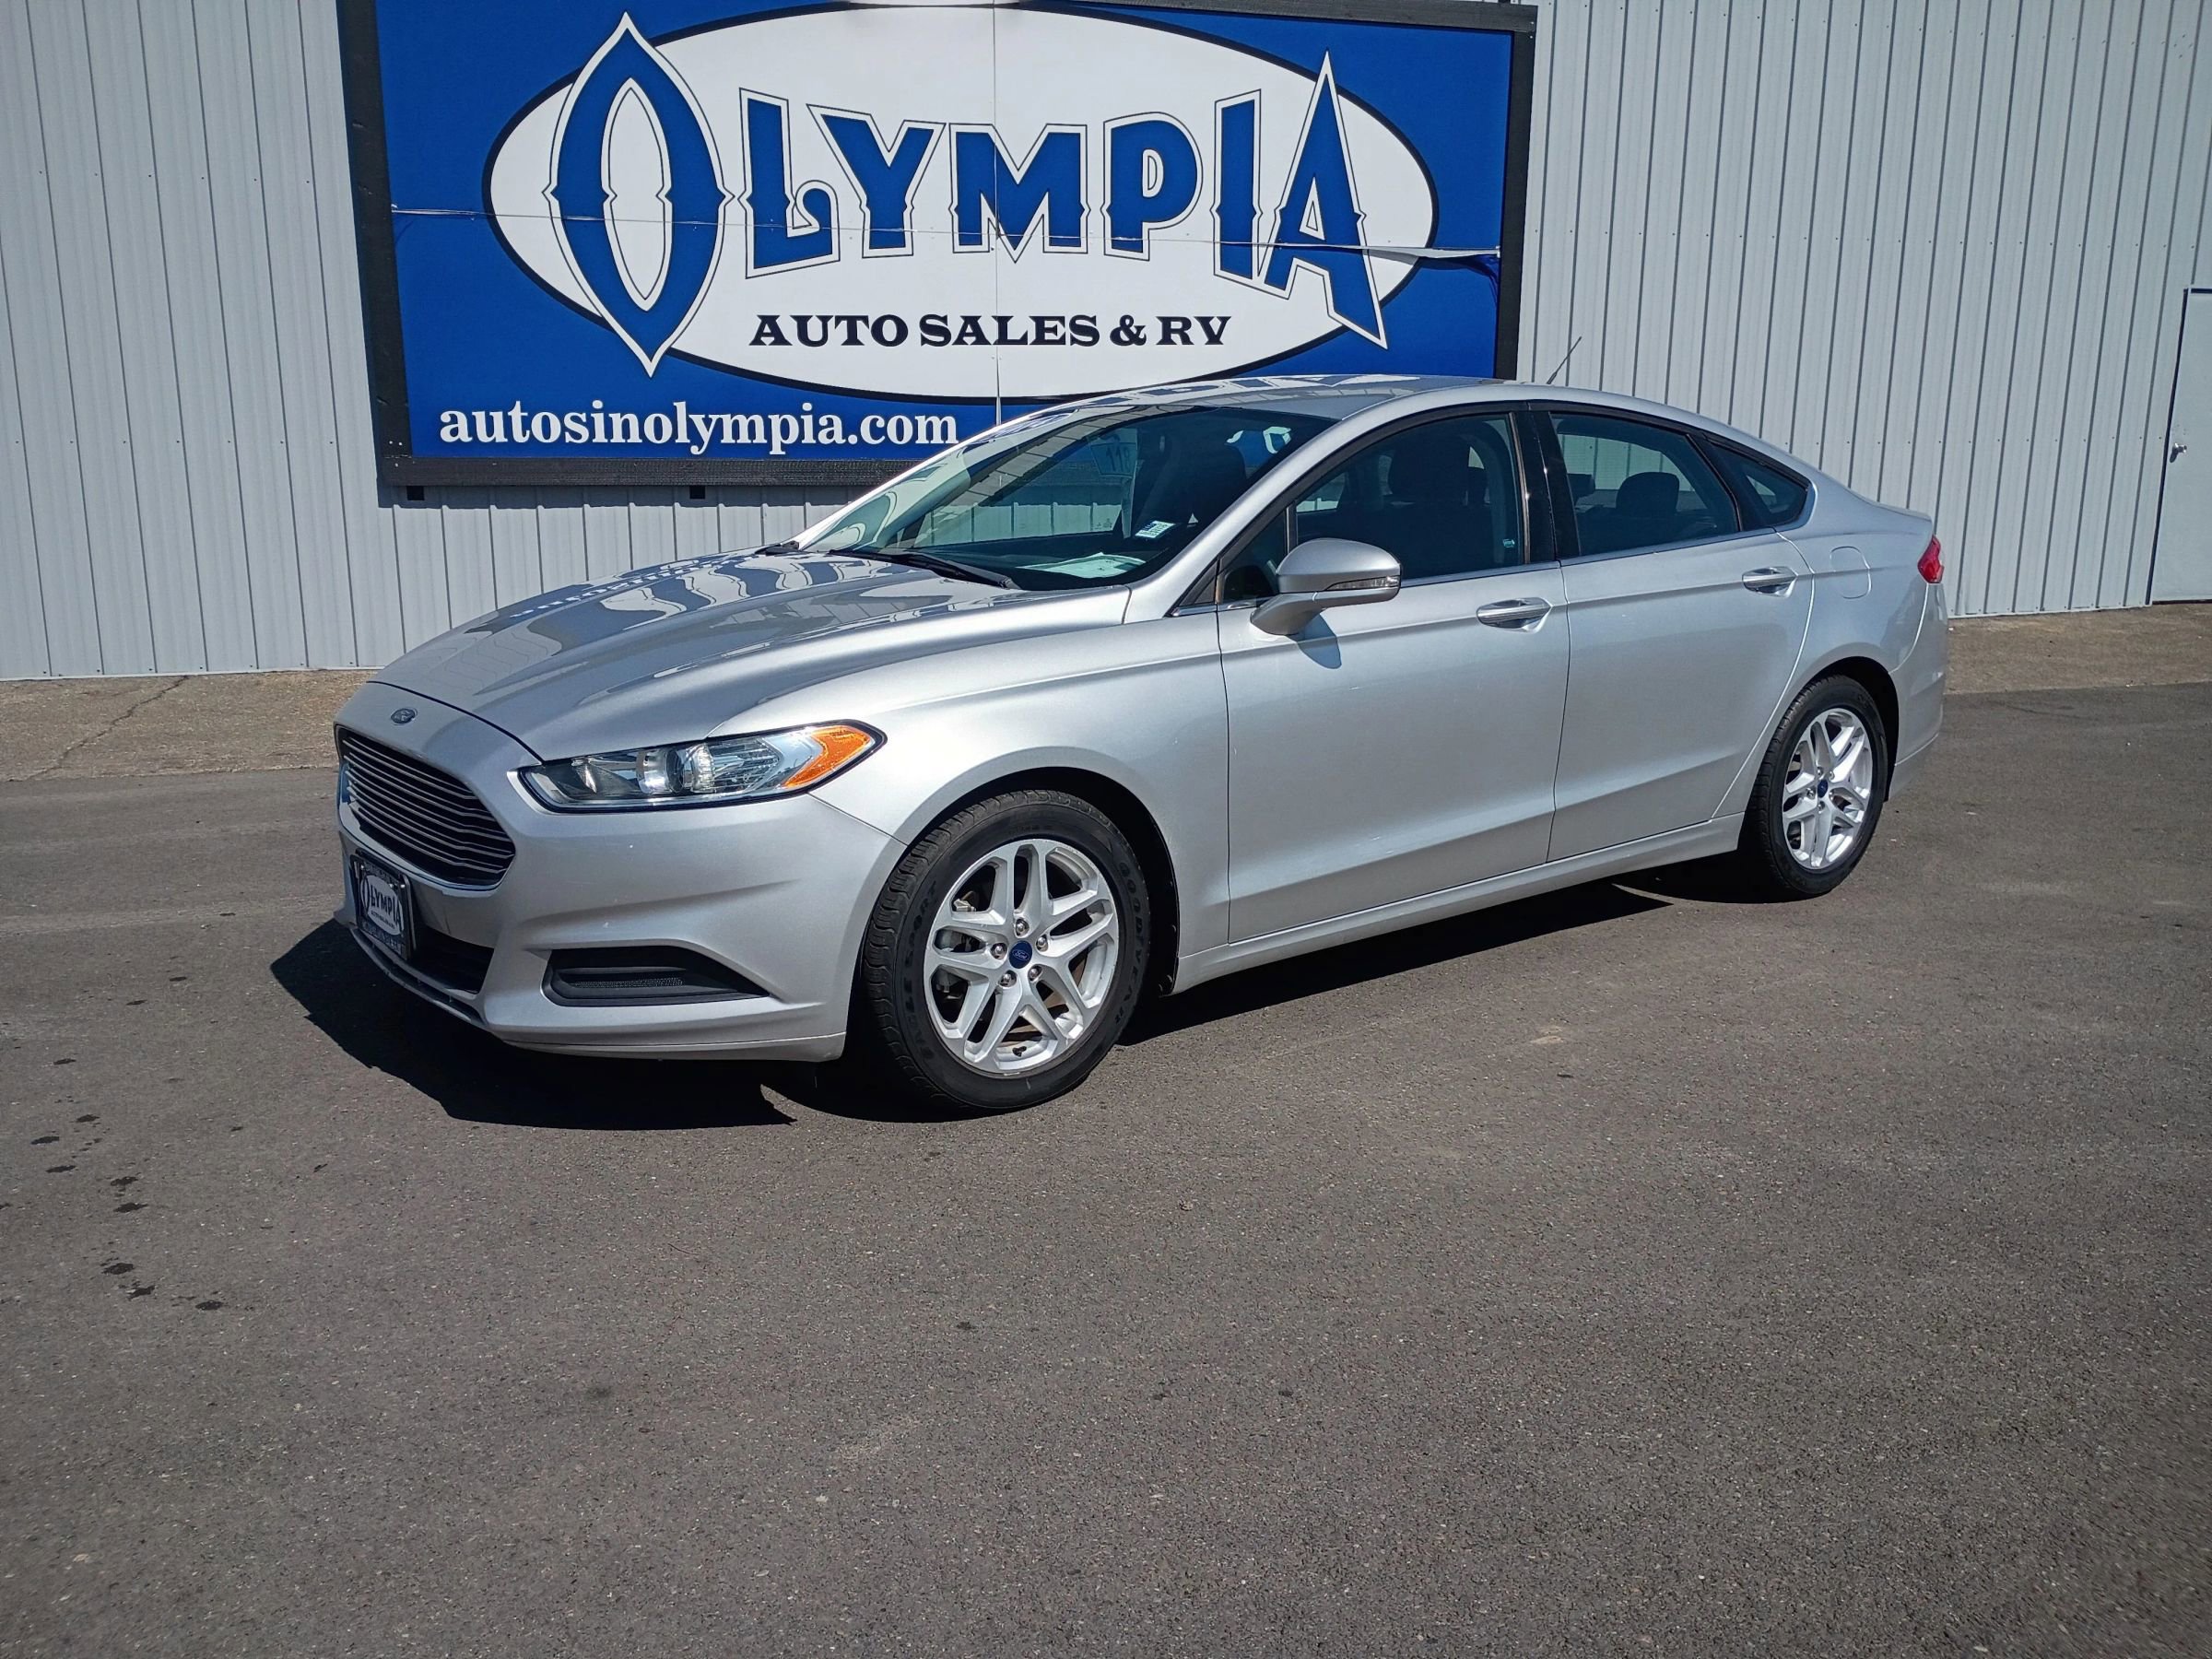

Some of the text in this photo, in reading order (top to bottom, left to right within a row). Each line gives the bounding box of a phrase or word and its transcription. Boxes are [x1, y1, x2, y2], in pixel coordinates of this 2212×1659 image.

[541, 11, 1388, 378] OLYMPIA
[748, 314, 1232, 347] AUTO SALES & RV
[440, 400, 959, 455] autosinolympia.com
[1114, 862, 1144, 1025] GOODYEAR
